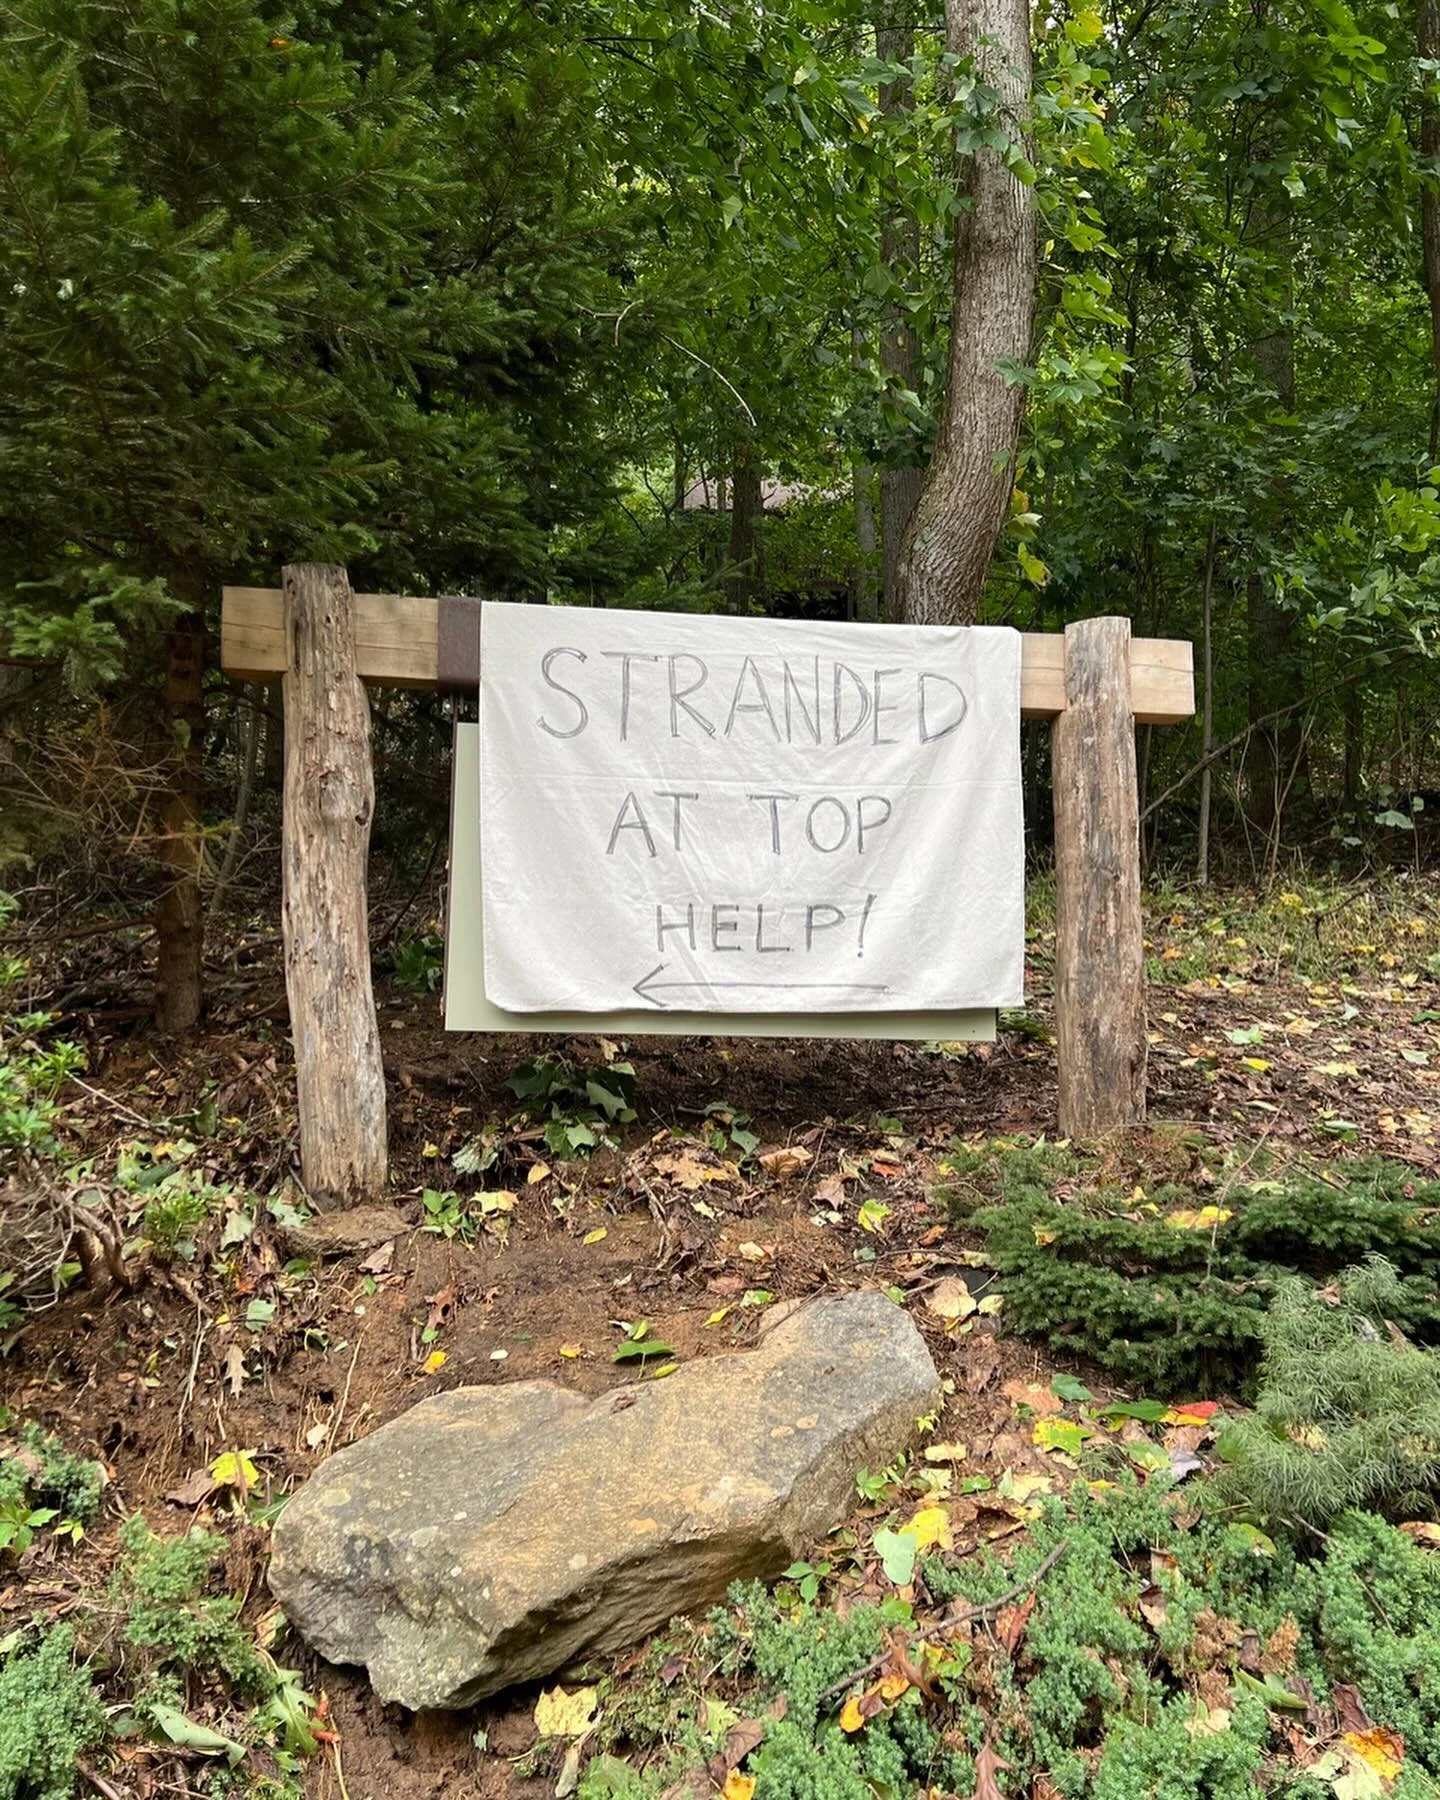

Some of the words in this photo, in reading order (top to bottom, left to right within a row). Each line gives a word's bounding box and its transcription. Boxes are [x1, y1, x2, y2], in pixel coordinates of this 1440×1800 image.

[536, 646, 968, 746] STRANDED
[605, 791, 699, 858] AT
[746, 792, 892, 856] TOP
[656, 893, 878, 959] HELP!
